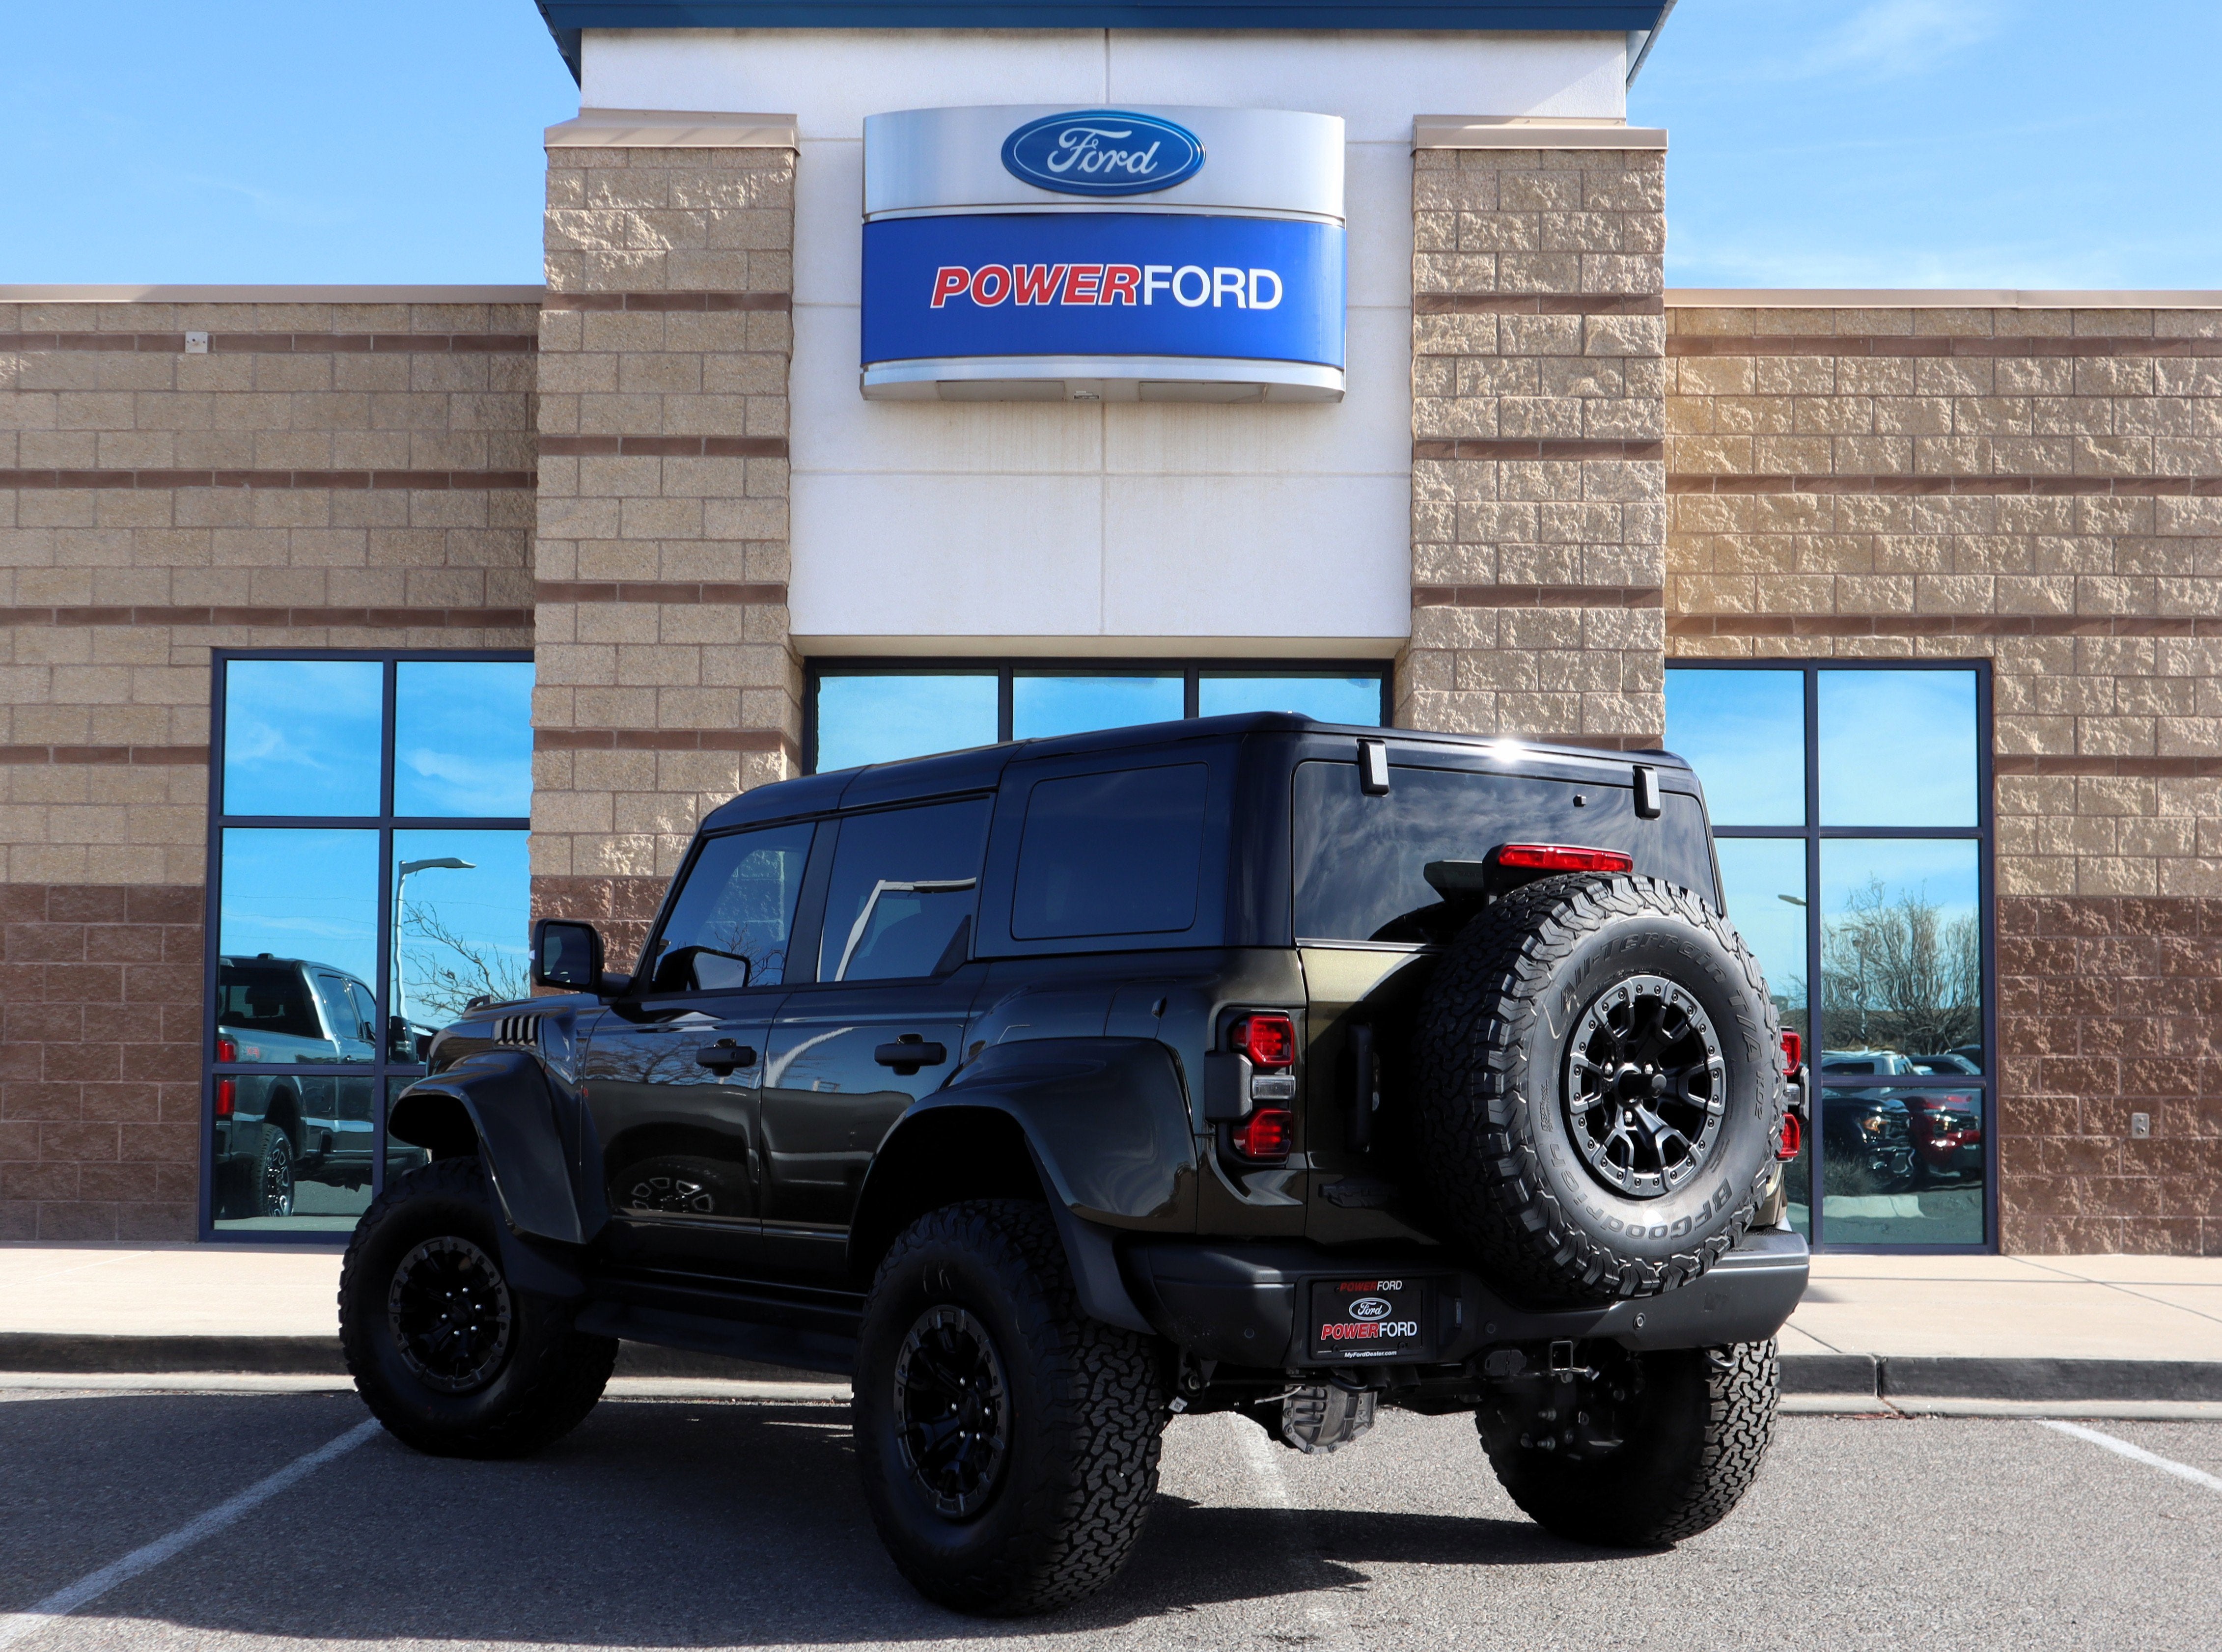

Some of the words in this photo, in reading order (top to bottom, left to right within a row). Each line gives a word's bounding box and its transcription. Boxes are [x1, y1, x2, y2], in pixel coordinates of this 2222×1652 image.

[1046, 128, 1161, 174] Ford
[1560, 932, 1727, 1016] All-Terrain
[1728, 989, 1762, 1062] T/A
[1550, 1143, 1733, 1240] BFGoodrich
[1357, 1302, 1383, 1316] Ford
[1344, 1350, 1397, 1359] MyFordDealer.com
